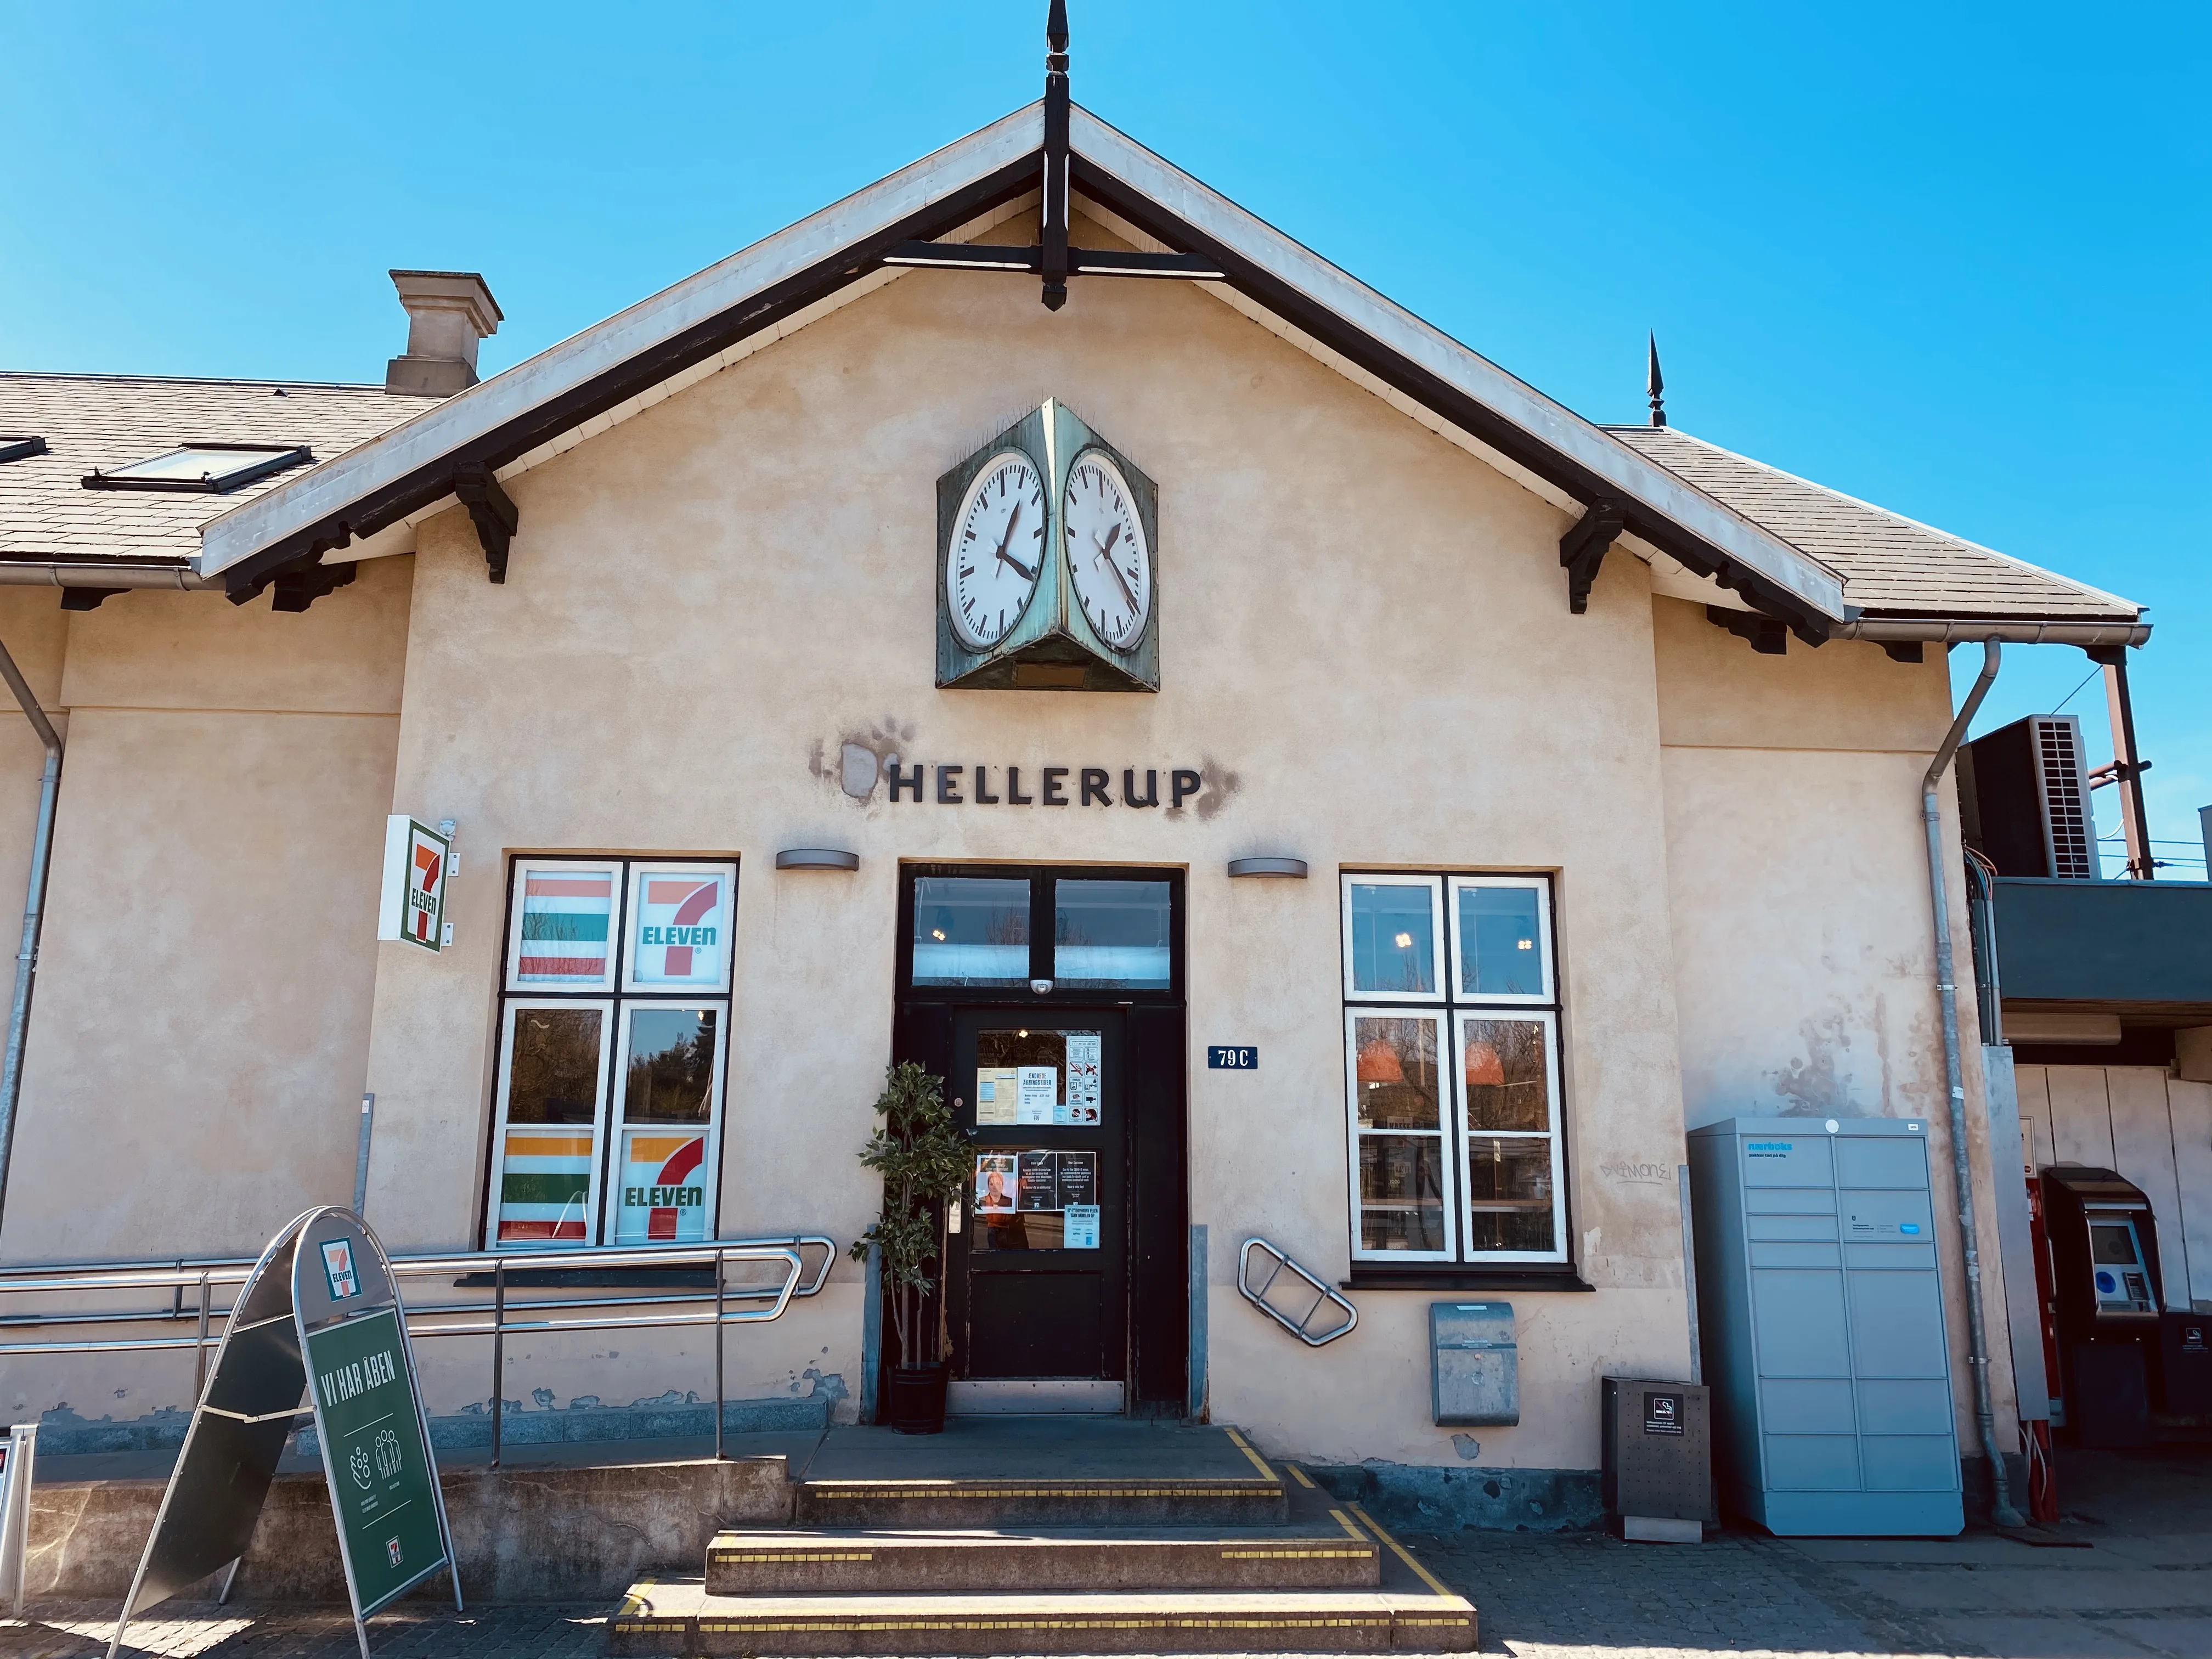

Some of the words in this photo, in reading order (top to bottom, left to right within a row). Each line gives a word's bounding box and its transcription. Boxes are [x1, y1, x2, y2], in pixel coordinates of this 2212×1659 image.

[889, 764, 1202, 809] HELLERUP
[1218, 1049, 1236, 1066] 79
[1239, 1049, 1248, 1066] C
[1748, 1142, 1793, 1150] nærboks
[320, 1372, 337, 1407] VI
[336, 1363, 364, 1401] HAR
[363, 1350, 396, 1391] ÅBEN
